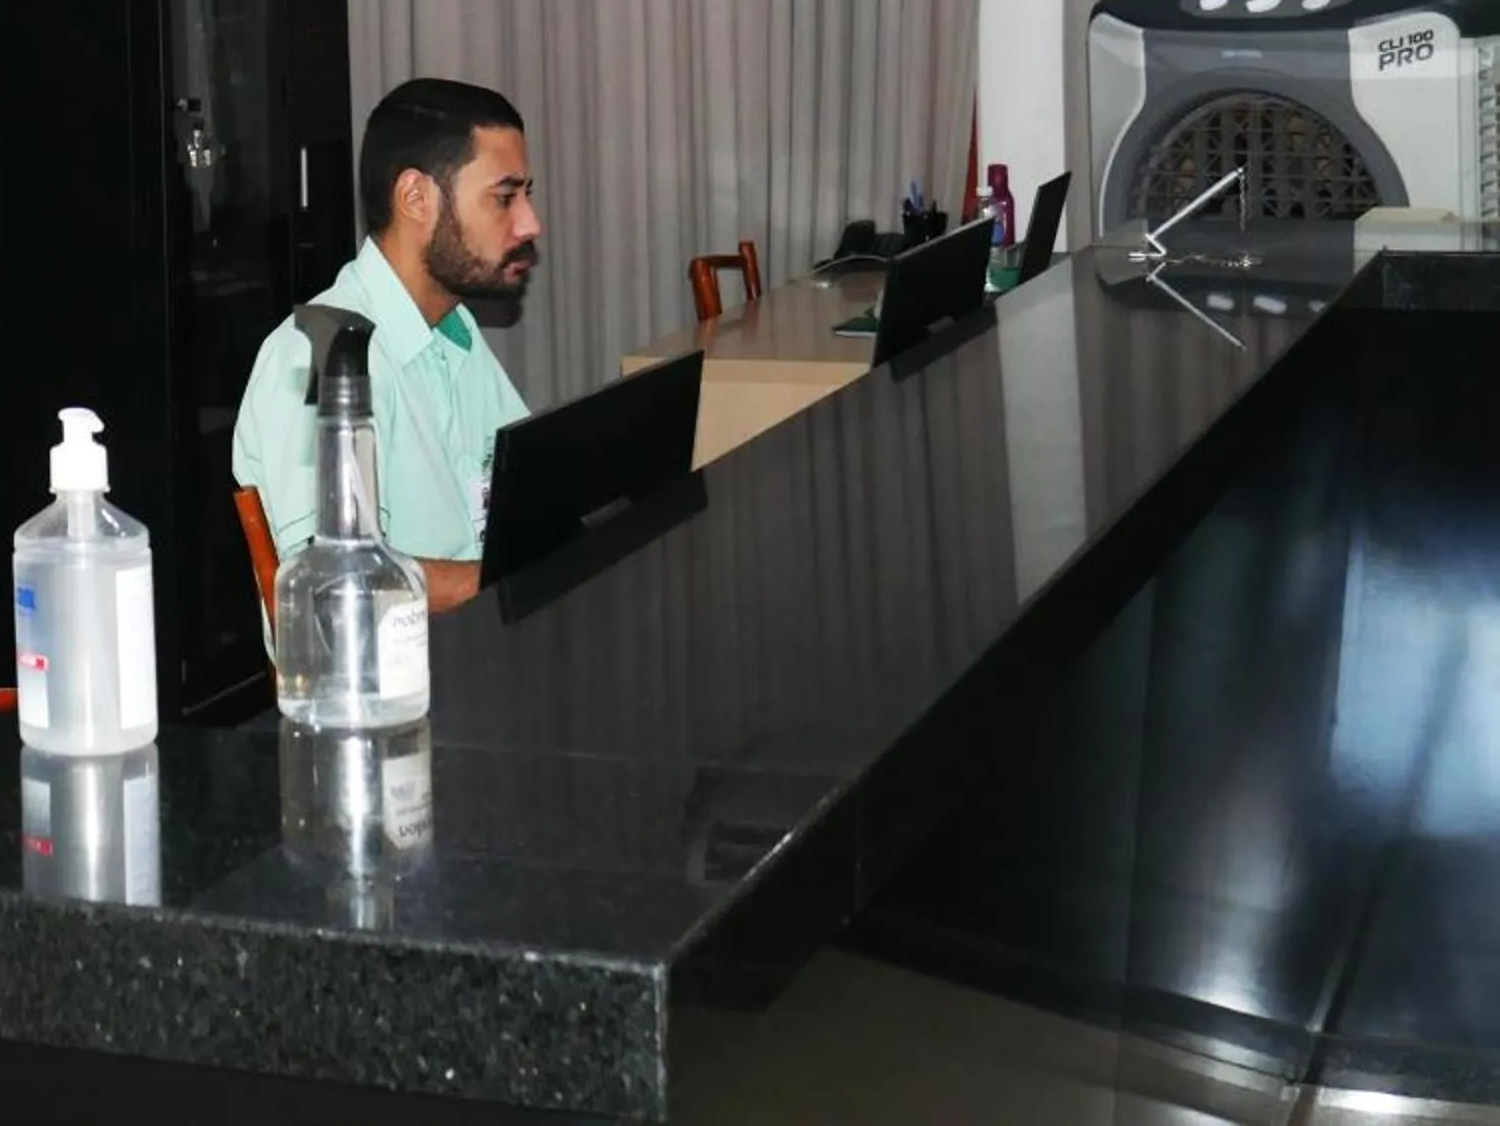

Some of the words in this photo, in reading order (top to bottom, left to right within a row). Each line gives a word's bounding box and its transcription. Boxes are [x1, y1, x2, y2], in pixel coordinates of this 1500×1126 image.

[1378, 37, 1405, 53] CLI
[1407, 29, 1434, 45] 100
[1379, 43, 1434, 72] PRO
